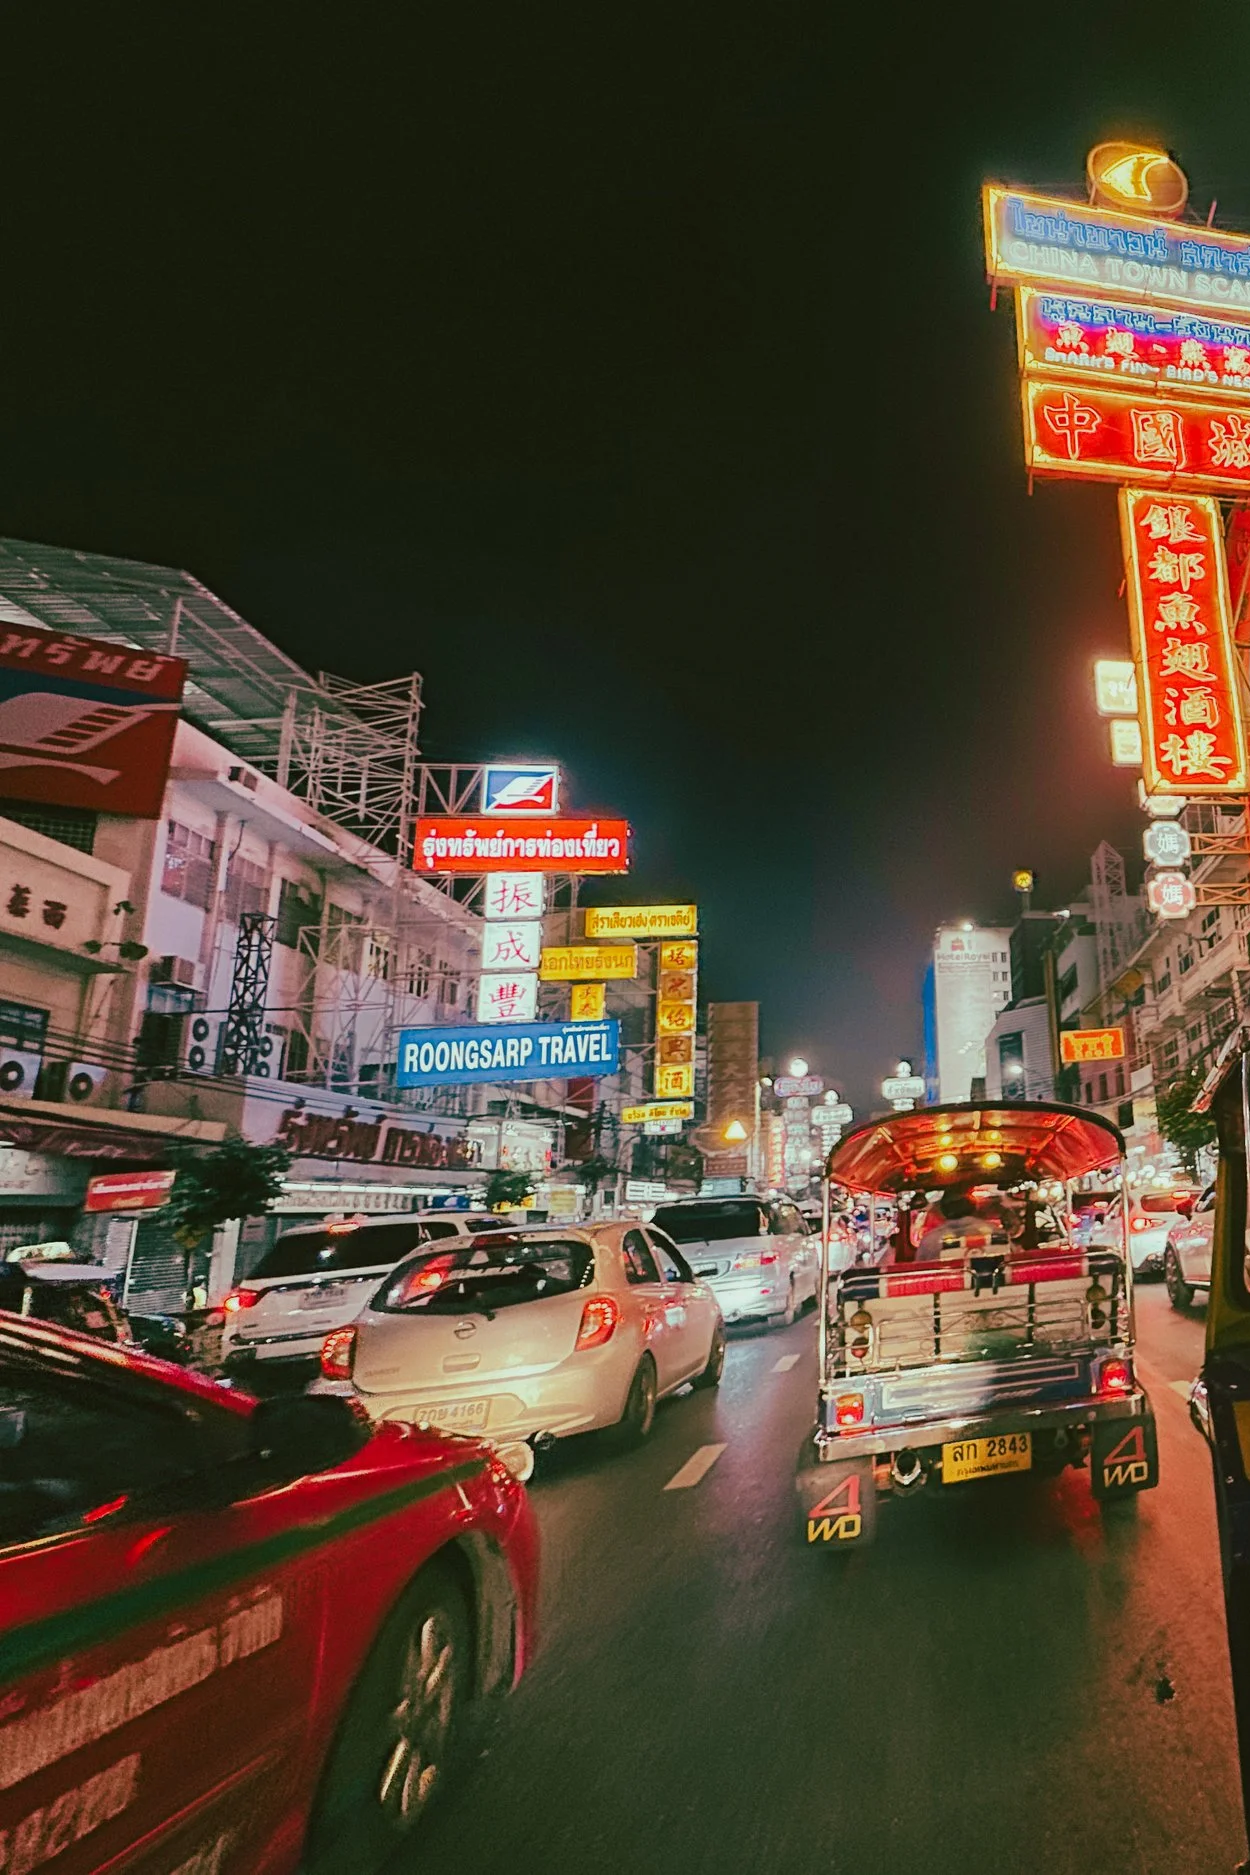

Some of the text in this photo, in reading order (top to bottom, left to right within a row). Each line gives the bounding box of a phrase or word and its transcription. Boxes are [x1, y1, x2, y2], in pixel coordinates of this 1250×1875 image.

[1008, 240, 1099, 278] CHINA
[1105, 257, 1188, 295] TOWN
[1140, 503, 1232, 778] 銀都魚翅酒樓
[490, 879, 538, 1019] 振成豐
[404, 1034, 611, 1074] ROONGSARP TRAVEL
[449, 1403, 484, 1418] 4166
[987, 1434, 1029, 1458] 2843
